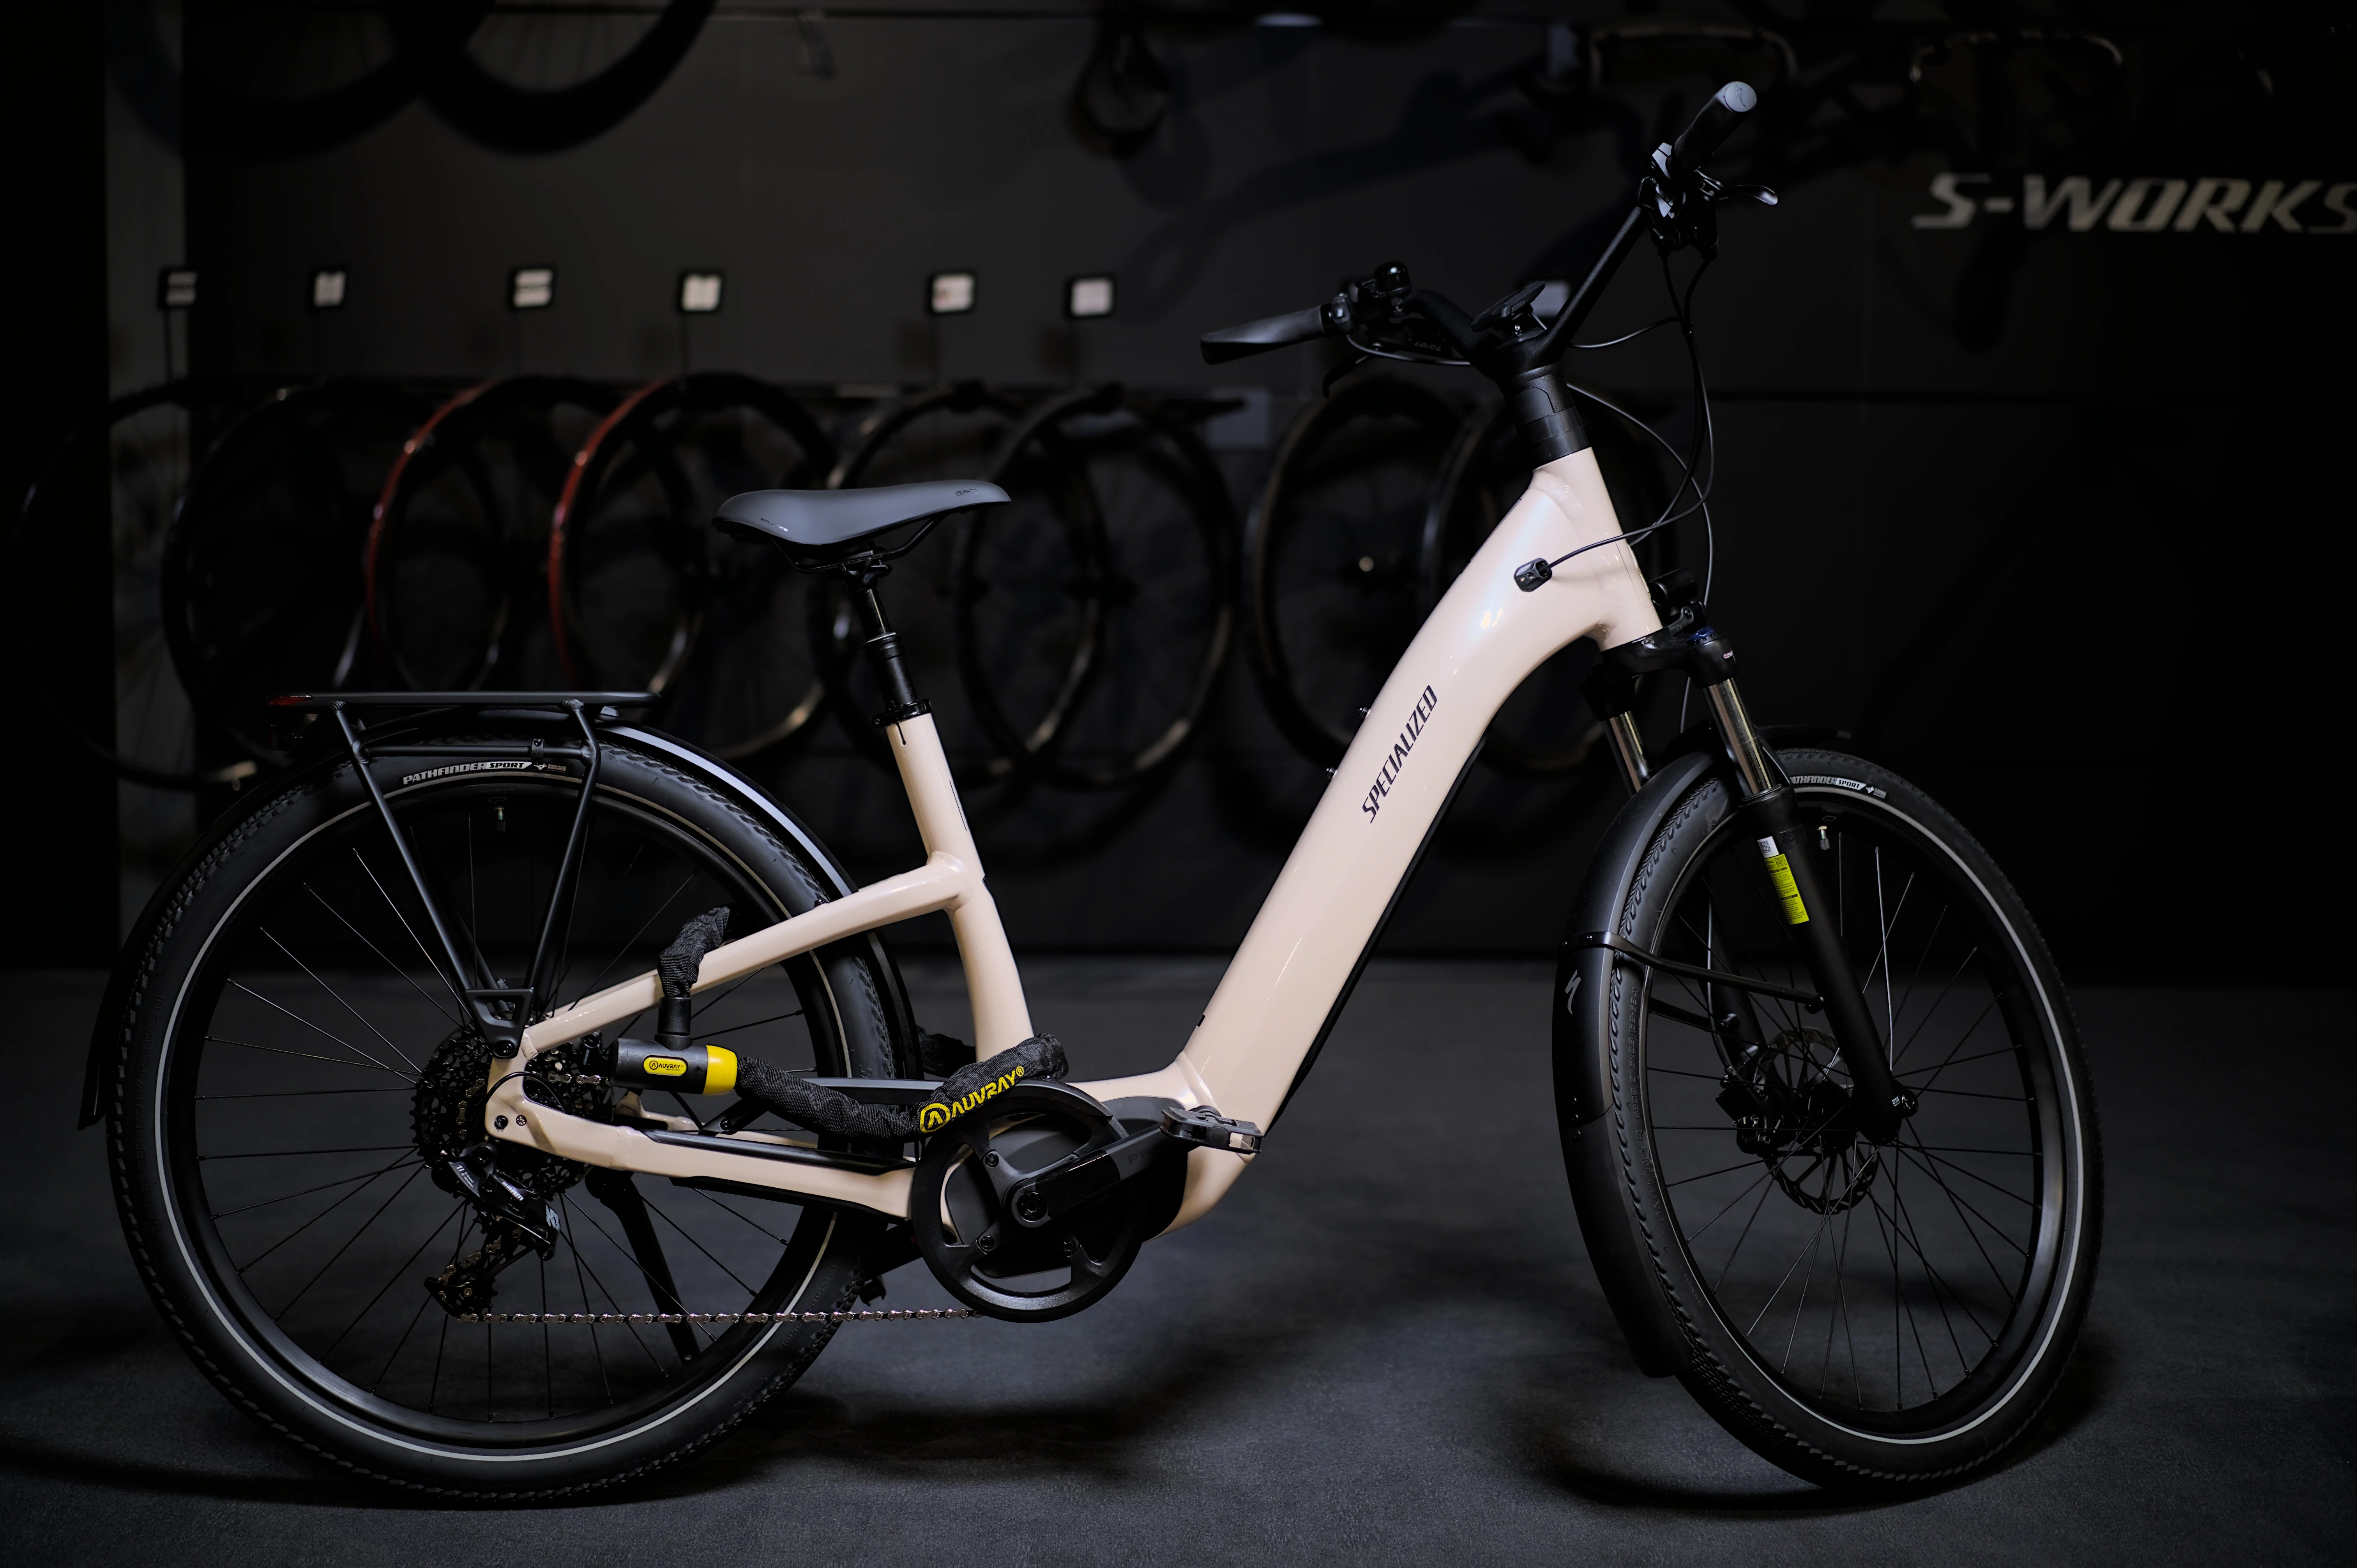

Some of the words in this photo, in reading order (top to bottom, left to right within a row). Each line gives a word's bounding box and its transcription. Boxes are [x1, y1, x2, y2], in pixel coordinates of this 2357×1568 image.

[1912, 172, 2357, 234] S-WORKS
[1362, 685, 1437, 823] SPECIALIZED
[403, 762, 488, 785] PATHFINDER
[1790, 775, 1836, 785] ATHFINDER
[1838, 779, 1860, 788] SPORT
[502, 1181, 524, 1201] SRAM
